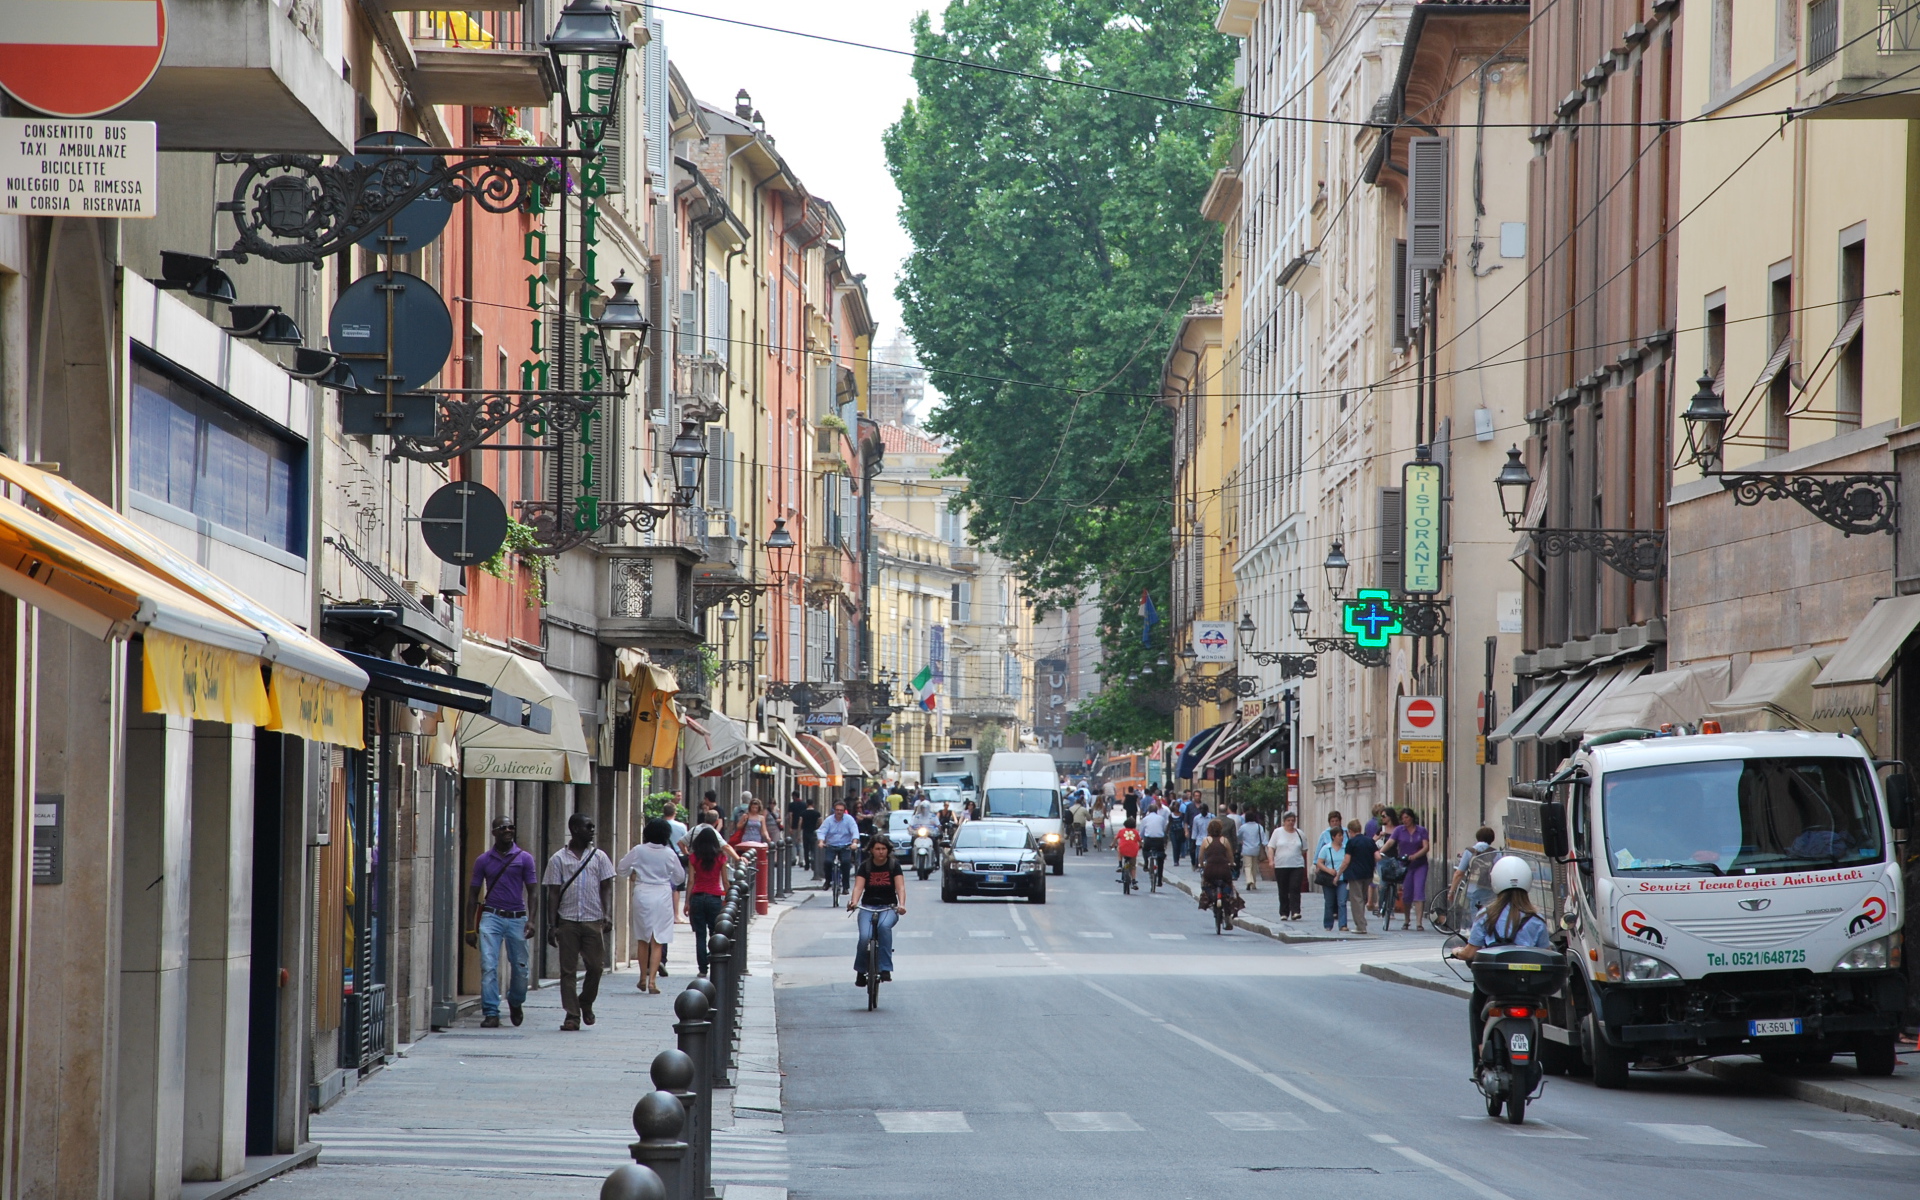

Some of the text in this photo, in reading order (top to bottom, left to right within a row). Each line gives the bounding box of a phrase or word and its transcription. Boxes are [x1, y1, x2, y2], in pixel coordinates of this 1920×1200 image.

[24, 124, 127, 140] CONSENTITO BUS
[20, 141, 127, 159] TAXI AMBULANZE
[41, 160, 106, 176] BICICLETTE
[7, 177, 142, 194] NOLEGGIO DA RIMESSA
[7, 195, 141, 212] IN CORSIA RISERVATA
[1414, 471, 1431, 586] RISTORANTE
[1244, 703, 1260, 717] BAR
[474, 753, 554, 776] Pasticceria
[696, 746, 740, 773] Fast Food
[1639, 871, 1864, 892] Servizi Tecnologici Ambientali
[1627, 934, 1665, 950] SPURGO FOGNE
[1707, 949, 1806, 967] Tel. 0521/648725
